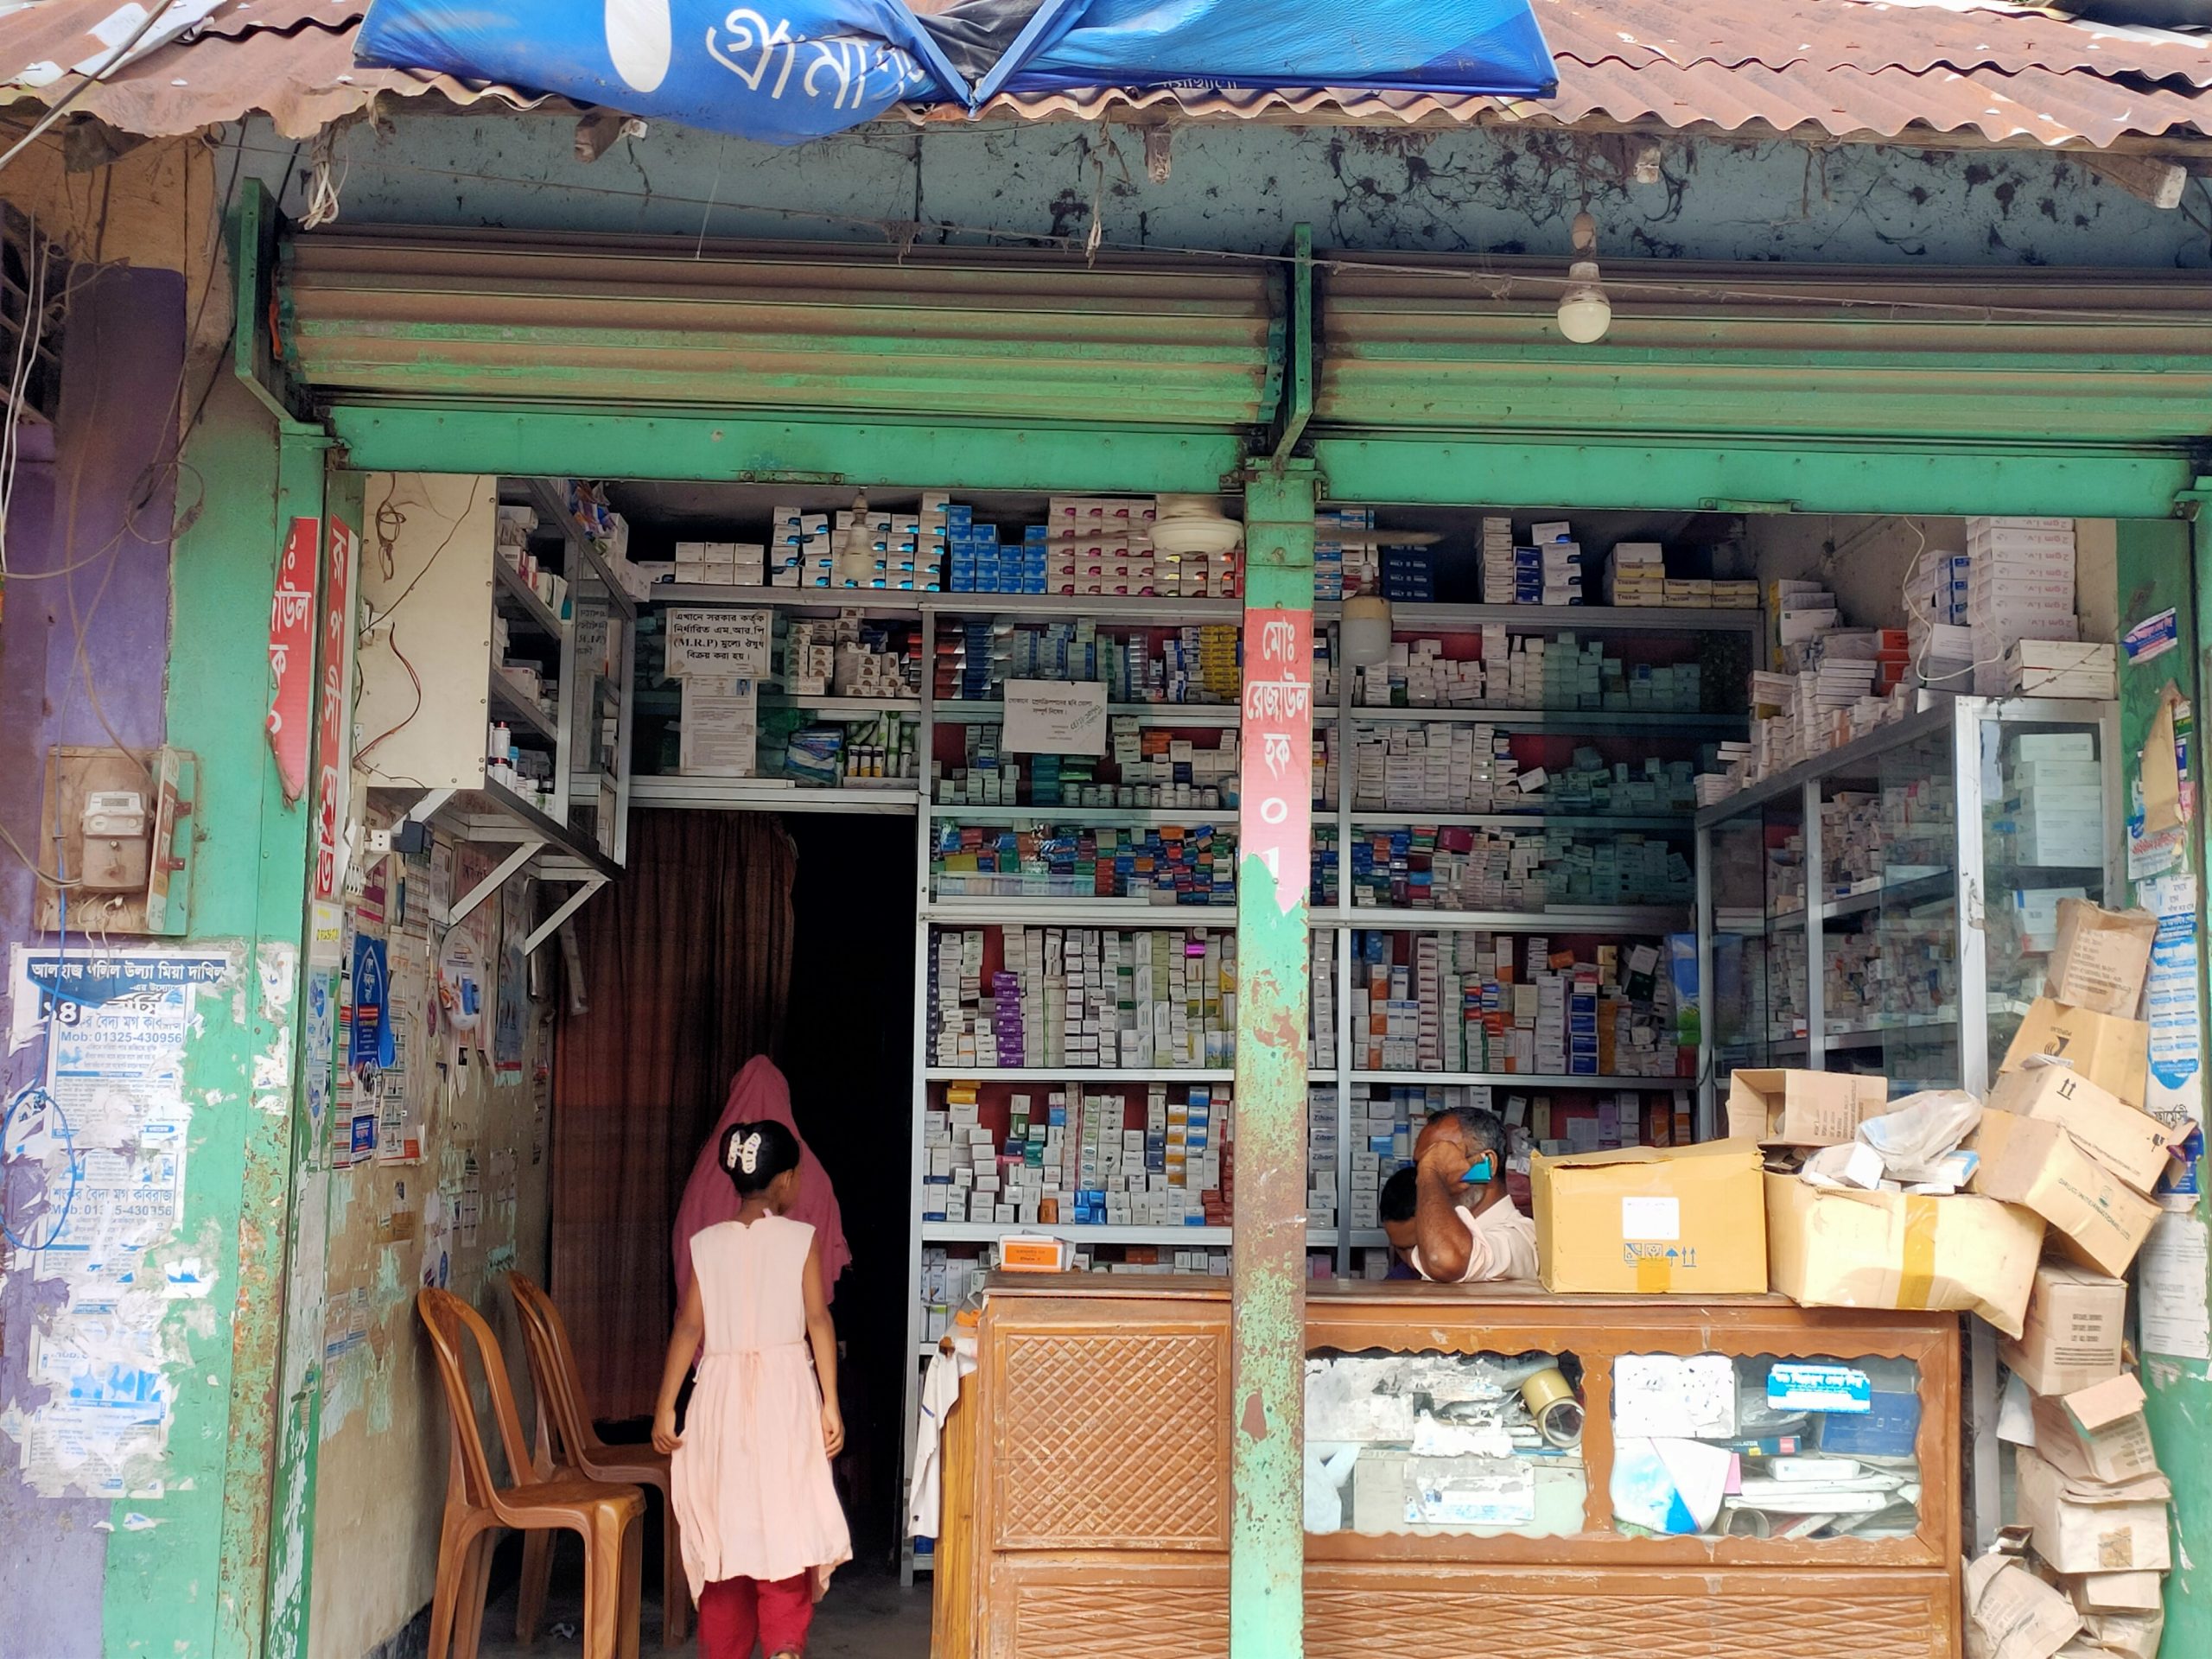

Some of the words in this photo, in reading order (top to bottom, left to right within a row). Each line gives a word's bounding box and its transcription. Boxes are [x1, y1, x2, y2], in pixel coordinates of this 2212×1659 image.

[674, 623, 710, 633] নির্ধারিত
[673, 639, 718, 649] (M.R.P)
[1262, 616, 1295, 664] মোঃ
[687, 649, 710, 659] বিক্রয়
[1246, 669, 1312, 724] রেজাউল
[1263, 734, 1291, 780] হক
[31, 961, 58, 979] আল
[158, 961, 184, 980] মিয়া
[60, 1031, 92, 1042] Mob:
[94, 1032, 182, 1043] 01325-430956
[133, 1185, 175, 1202] কবিরাজ
